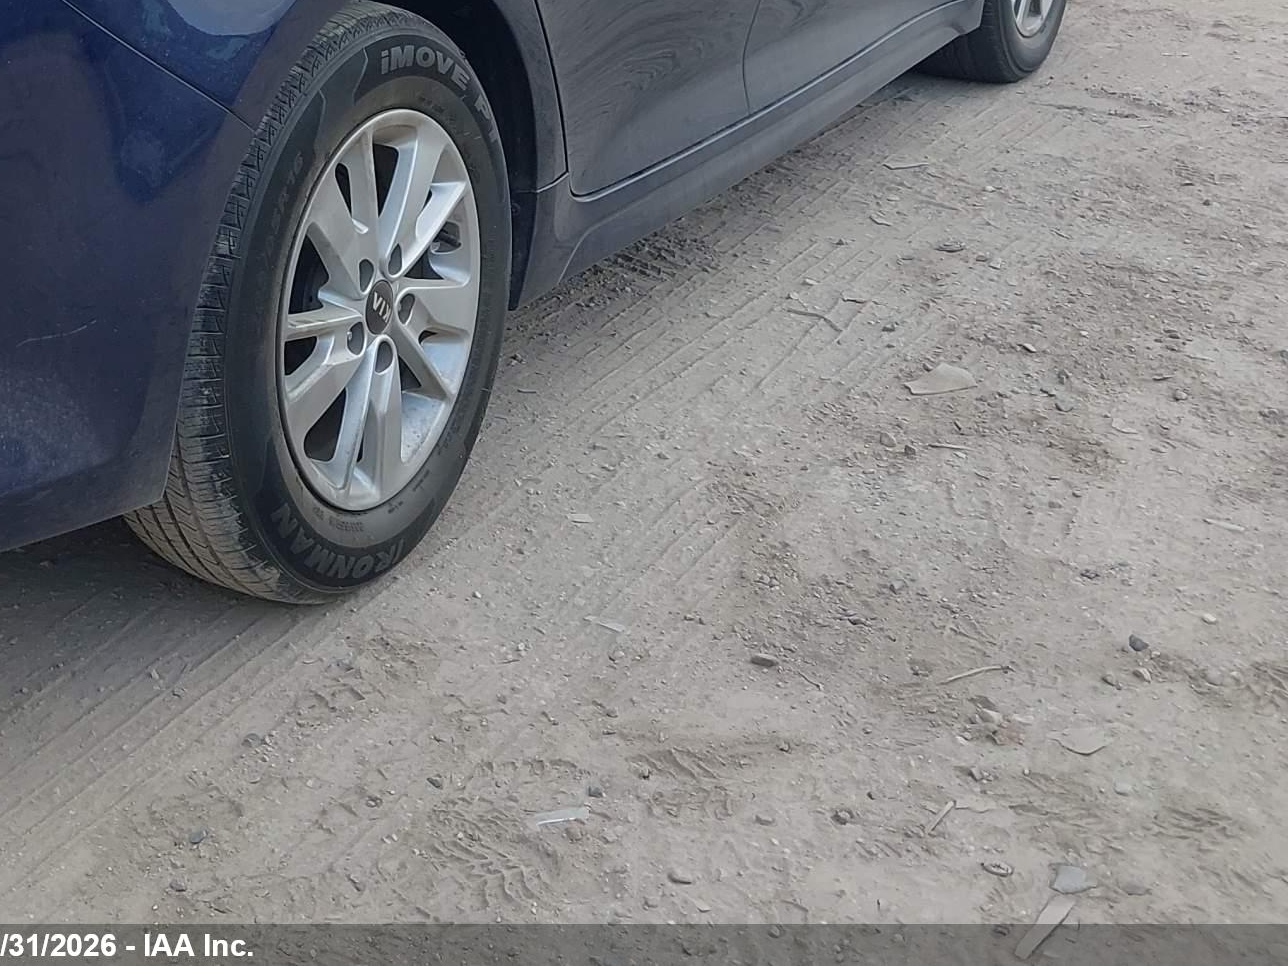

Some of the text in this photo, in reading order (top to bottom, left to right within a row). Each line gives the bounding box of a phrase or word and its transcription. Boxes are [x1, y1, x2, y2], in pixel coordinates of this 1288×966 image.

[381, 44, 471, 91] iMOVE
[372, 292, 392, 323] KIA
[271, 502, 406, 579] IRONMAN
